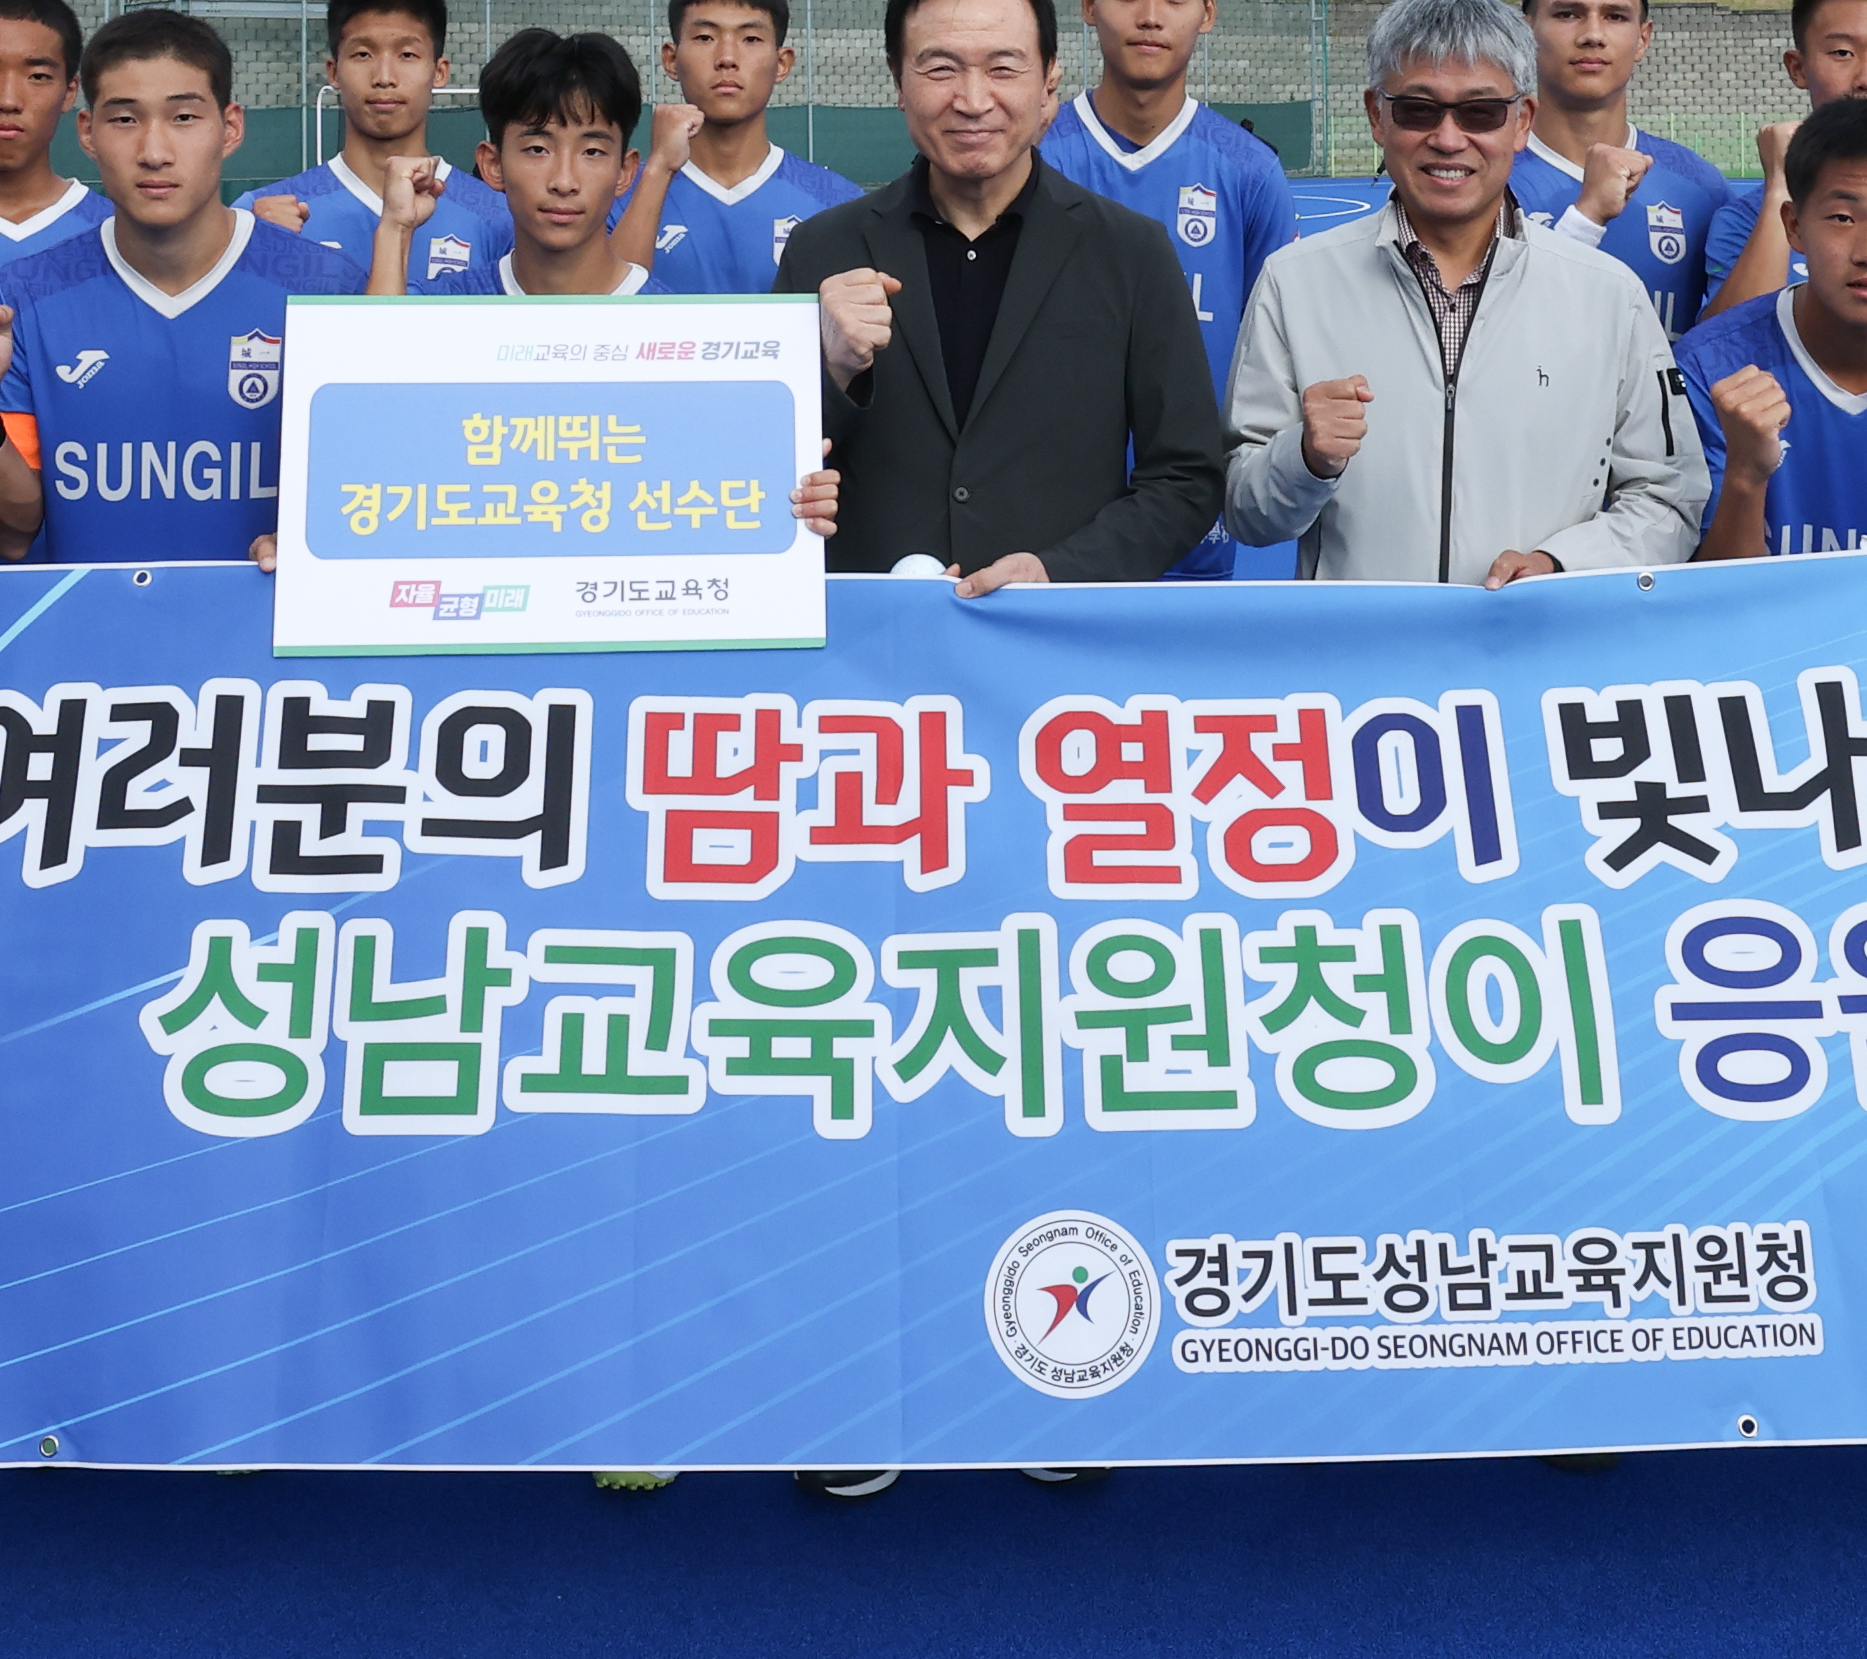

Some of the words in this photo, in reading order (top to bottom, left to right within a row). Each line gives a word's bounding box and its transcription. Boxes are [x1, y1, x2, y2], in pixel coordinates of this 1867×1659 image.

[497, 343, 587, 362] 미래교육의
[592, 344, 629, 362] 중심
[635, 341, 696, 361] 새로운
[700, 340, 781, 361] 경기교육
[462, 413, 647, 466] 함께뛰는
[54, 439, 279, 503] SUNGIL
[340, 478, 612, 536] 경기도교육청
[629, 479, 766, 531] 선수단
[394, 583, 437, 605] 자율
[438, 596, 480, 619] 균형
[485, 586, 525, 610] 미래
[575, 609, 632, 618] GYEONGGIDO
[635, 609, 665, 617] OFFICE
[668, 609, 679, 617] OF
[682, 608, 730, 617] EDUCATION
[576, 578, 730, 604] 경기도교육청
[643, 709, 974, 884] 땀과
[1036, 704, 1502, 884] 열정이
[159, 919, 1604, 1119] 성남교육지원청이
[1002, 1260, 1021, 1338] Gyeonggido
[1018, 1226, 1079, 1258] Seongnam
[1085, 1227, 1119, 1252] Office
[1119, 1253, 1134, 1266] of
[1128, 1269, 1145, 1335] Education
[1174, 1229, 1809, 1318] 경기도성남교육지원청
[1014, 1345, 1049, 1376] 경기도
[1050, 1341, 1135, 1384] 성남교육지원청
[1180, 1336, 1370, 1365] GYEONGGI-DO
[1376, 1330, 1529, 1360] SEONGNAM
[1535, 1328, 1623, 1358] OFFICE
[1631, 1327, 1665, 1353] OF
[1671, 1321, 1817, 1351] EDUCATION
